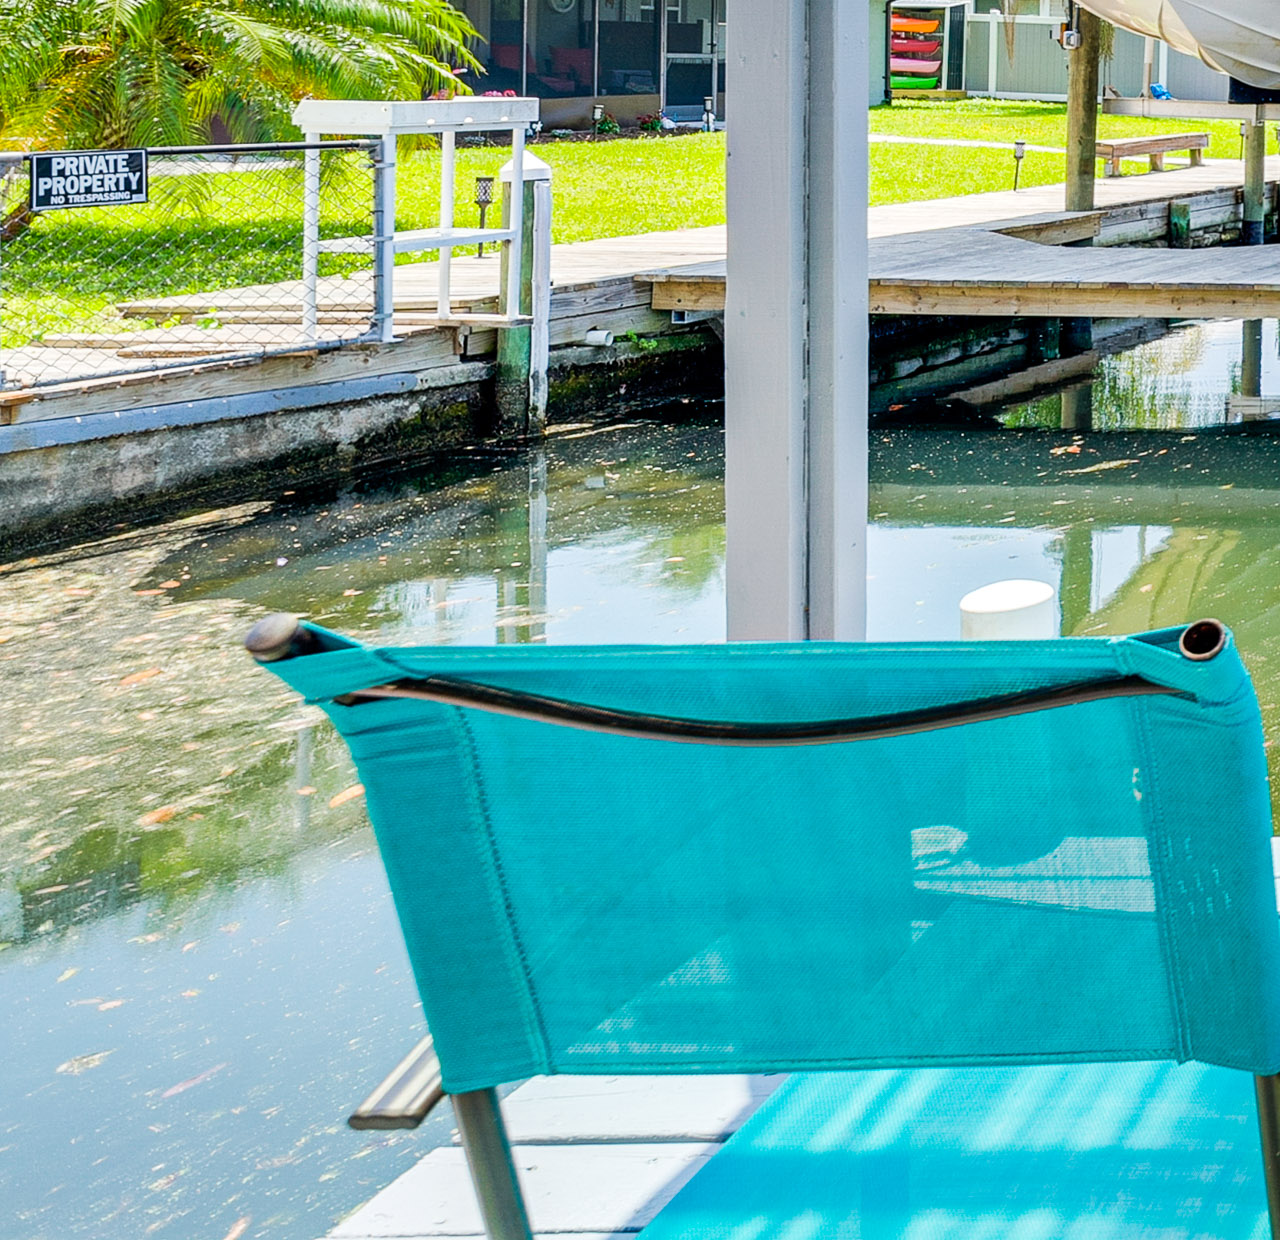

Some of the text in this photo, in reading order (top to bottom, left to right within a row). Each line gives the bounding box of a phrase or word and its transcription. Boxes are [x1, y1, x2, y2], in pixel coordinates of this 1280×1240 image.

[51, 154, 129, 176] PRIVATE
[38, 172, 141, 196] PROPERTY
[50, 191, 131, 205] NO TRESPASSING
